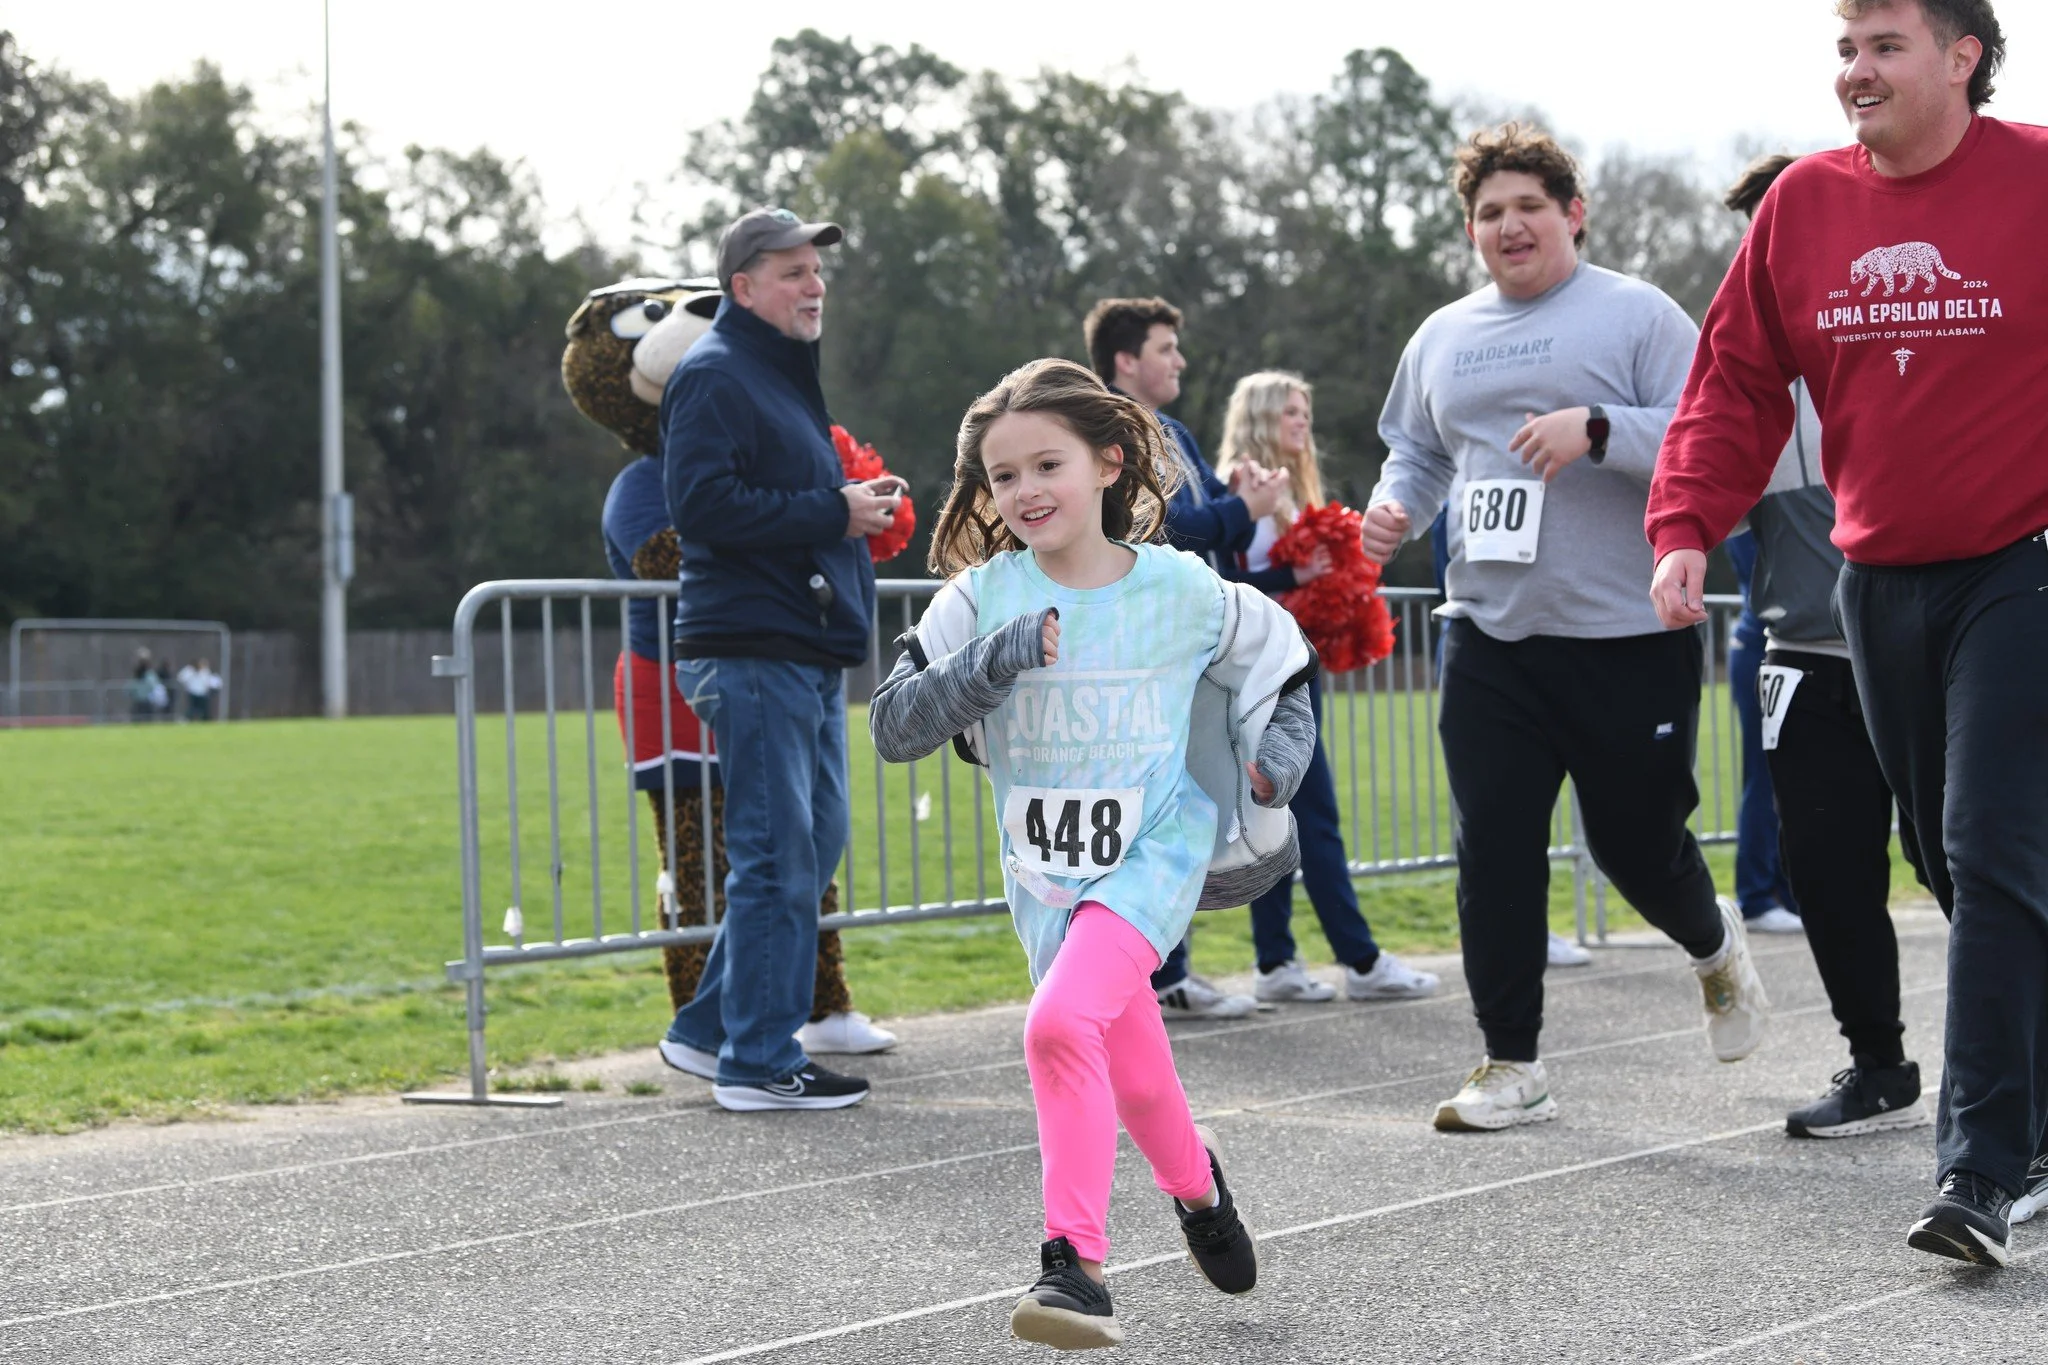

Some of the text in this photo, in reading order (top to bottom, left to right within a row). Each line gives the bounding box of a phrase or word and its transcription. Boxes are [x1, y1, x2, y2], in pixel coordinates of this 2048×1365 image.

[1828, 289, 1849, 299] 2023
[1962, 280, 1988, 289] 2024
[1817, 298, 2002, 330] ALPHA EPSILON DELTA
[1832, 327, 1986, 343] UNIVERSITY OF SOUTH ALABAMA
[1454, 337, 1554, 367] TRADEMARK
[1469, 487, 1528, 533] 680
[1033, 742, 1135, 763] ORANGE BEACH
[1025, 797, 1122, 868] 448
